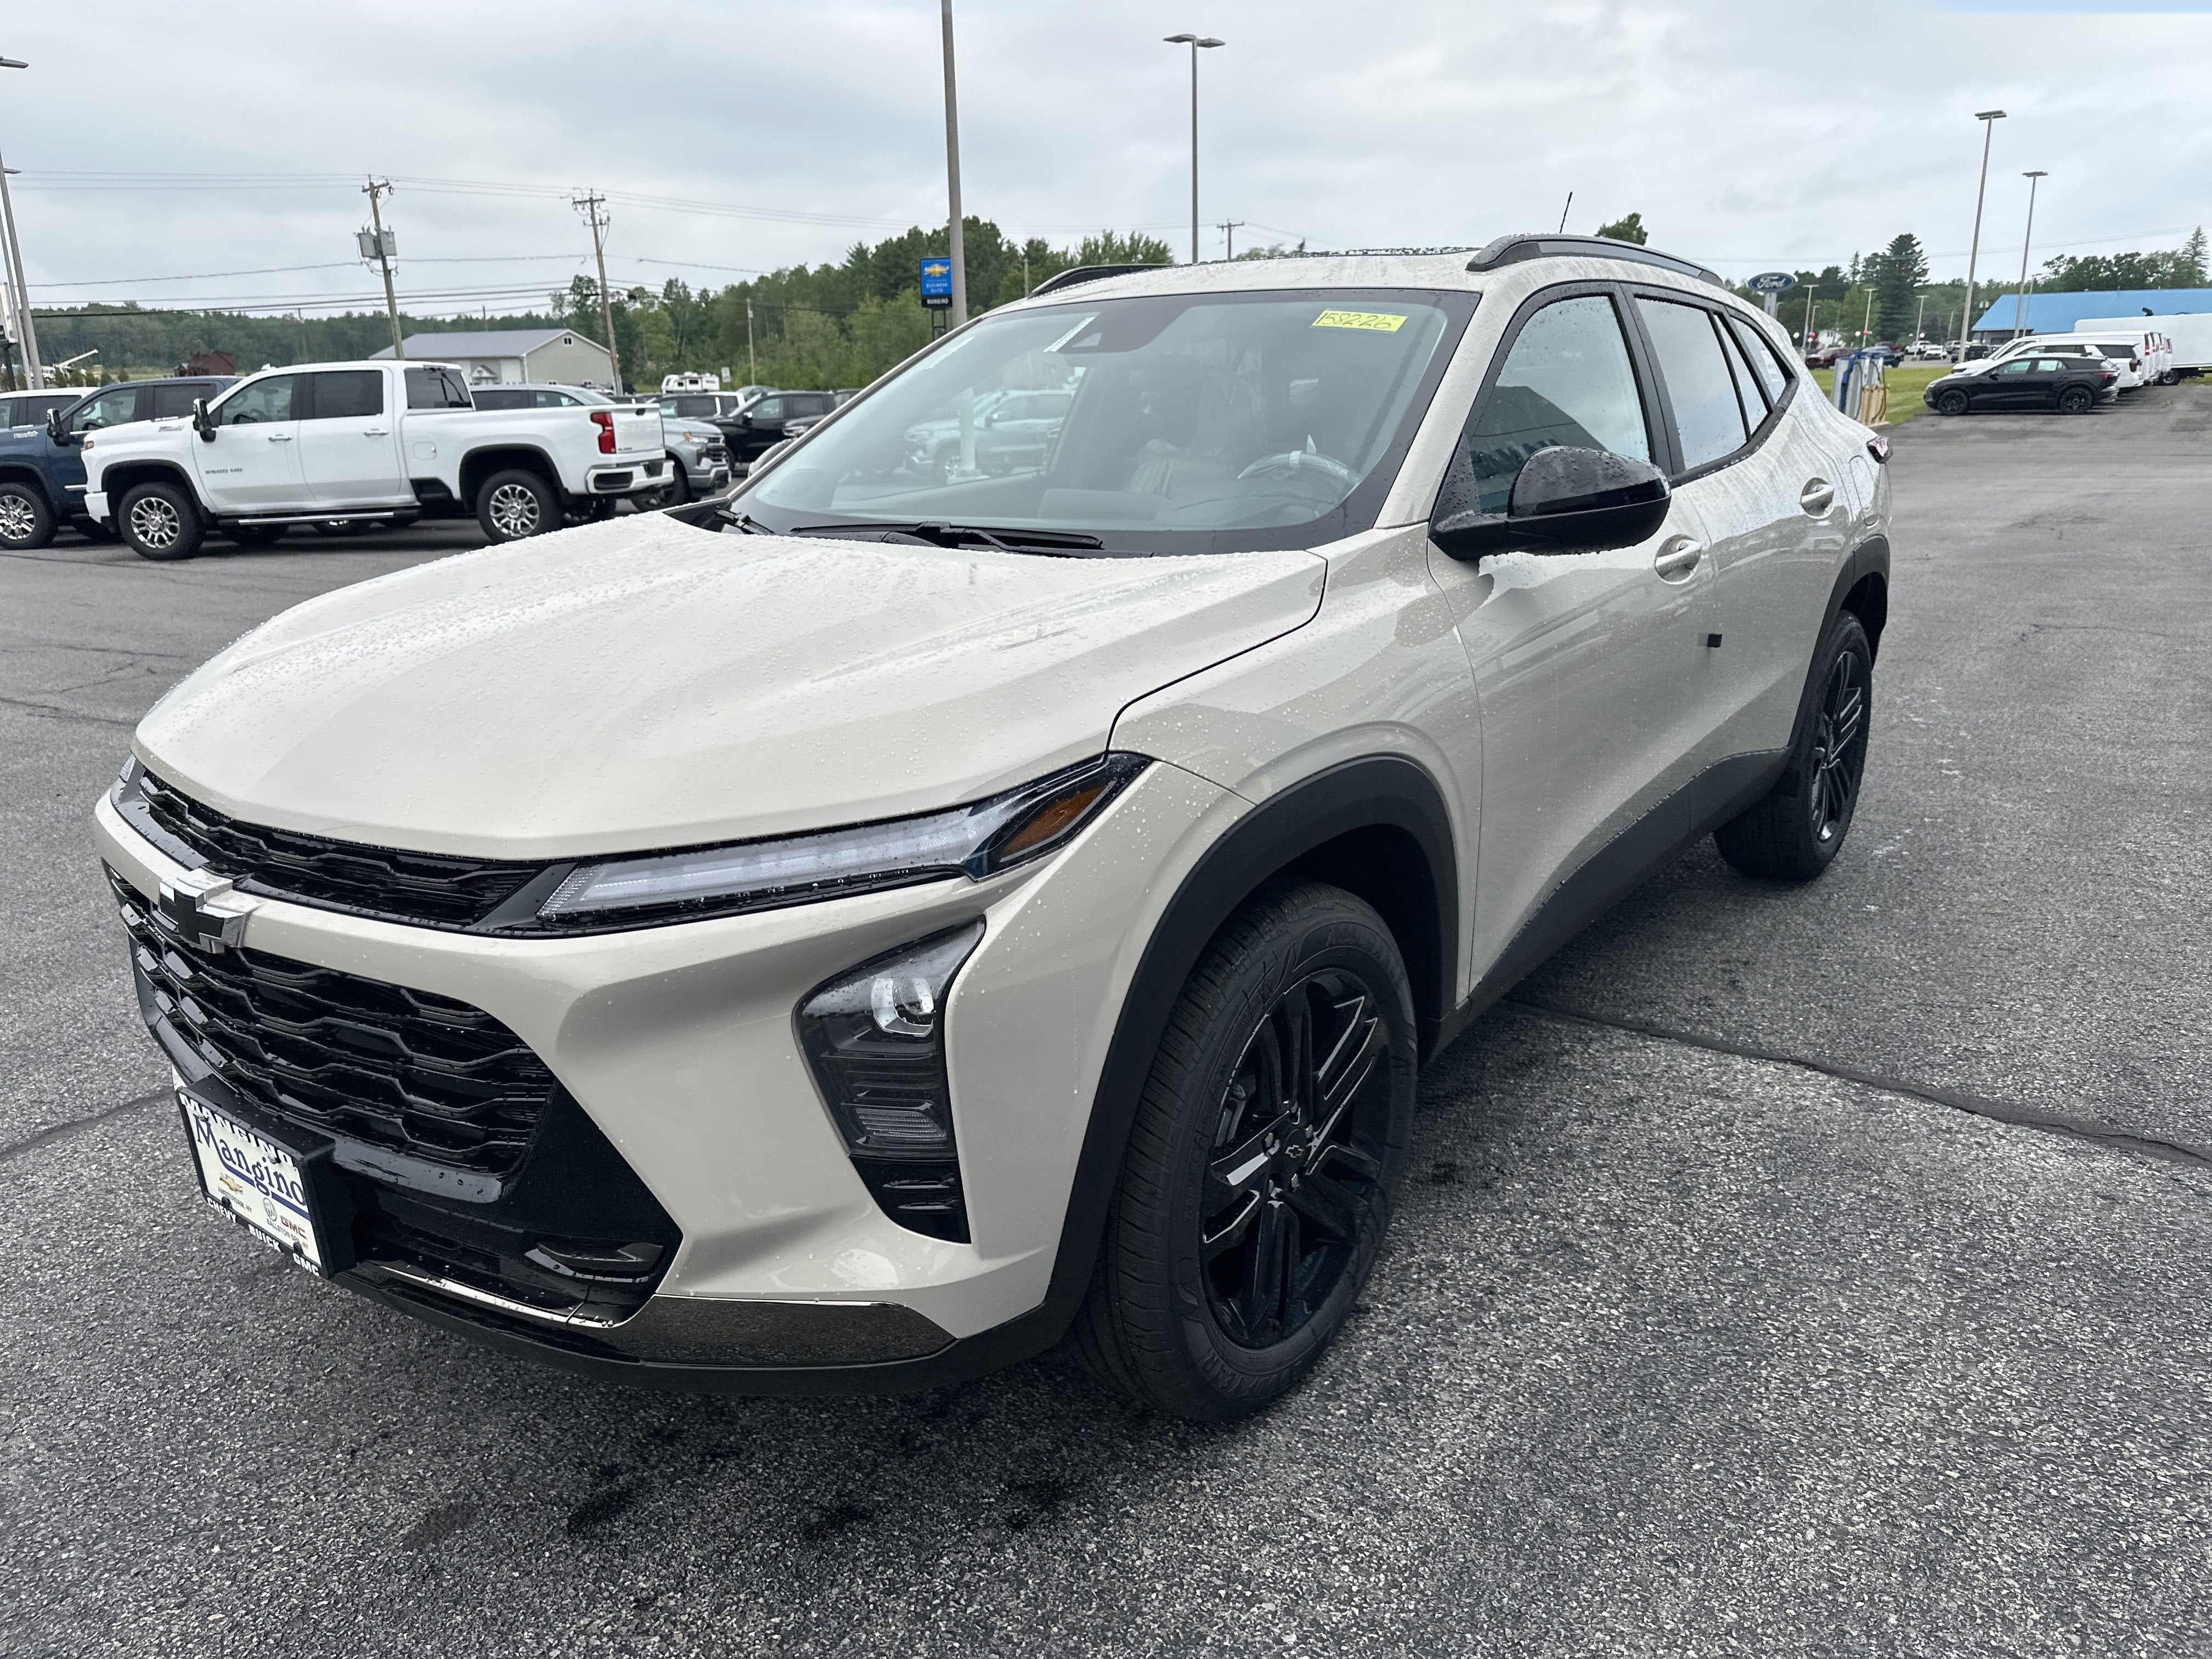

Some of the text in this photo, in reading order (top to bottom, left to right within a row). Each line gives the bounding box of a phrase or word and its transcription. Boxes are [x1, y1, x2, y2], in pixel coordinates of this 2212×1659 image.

[1757, 275, 1786, 289] Ford
[179, 1092, 294, 1167] MANGINO
[193, 1113, 307, 1206] Mangino
[207, 1197, 236, 1223] CHEVY
[249, 1224, 281, 1252] BUICK
[280, 1215, 307, 1239] GMC
[292, 1252, 319, 1276] GMC
